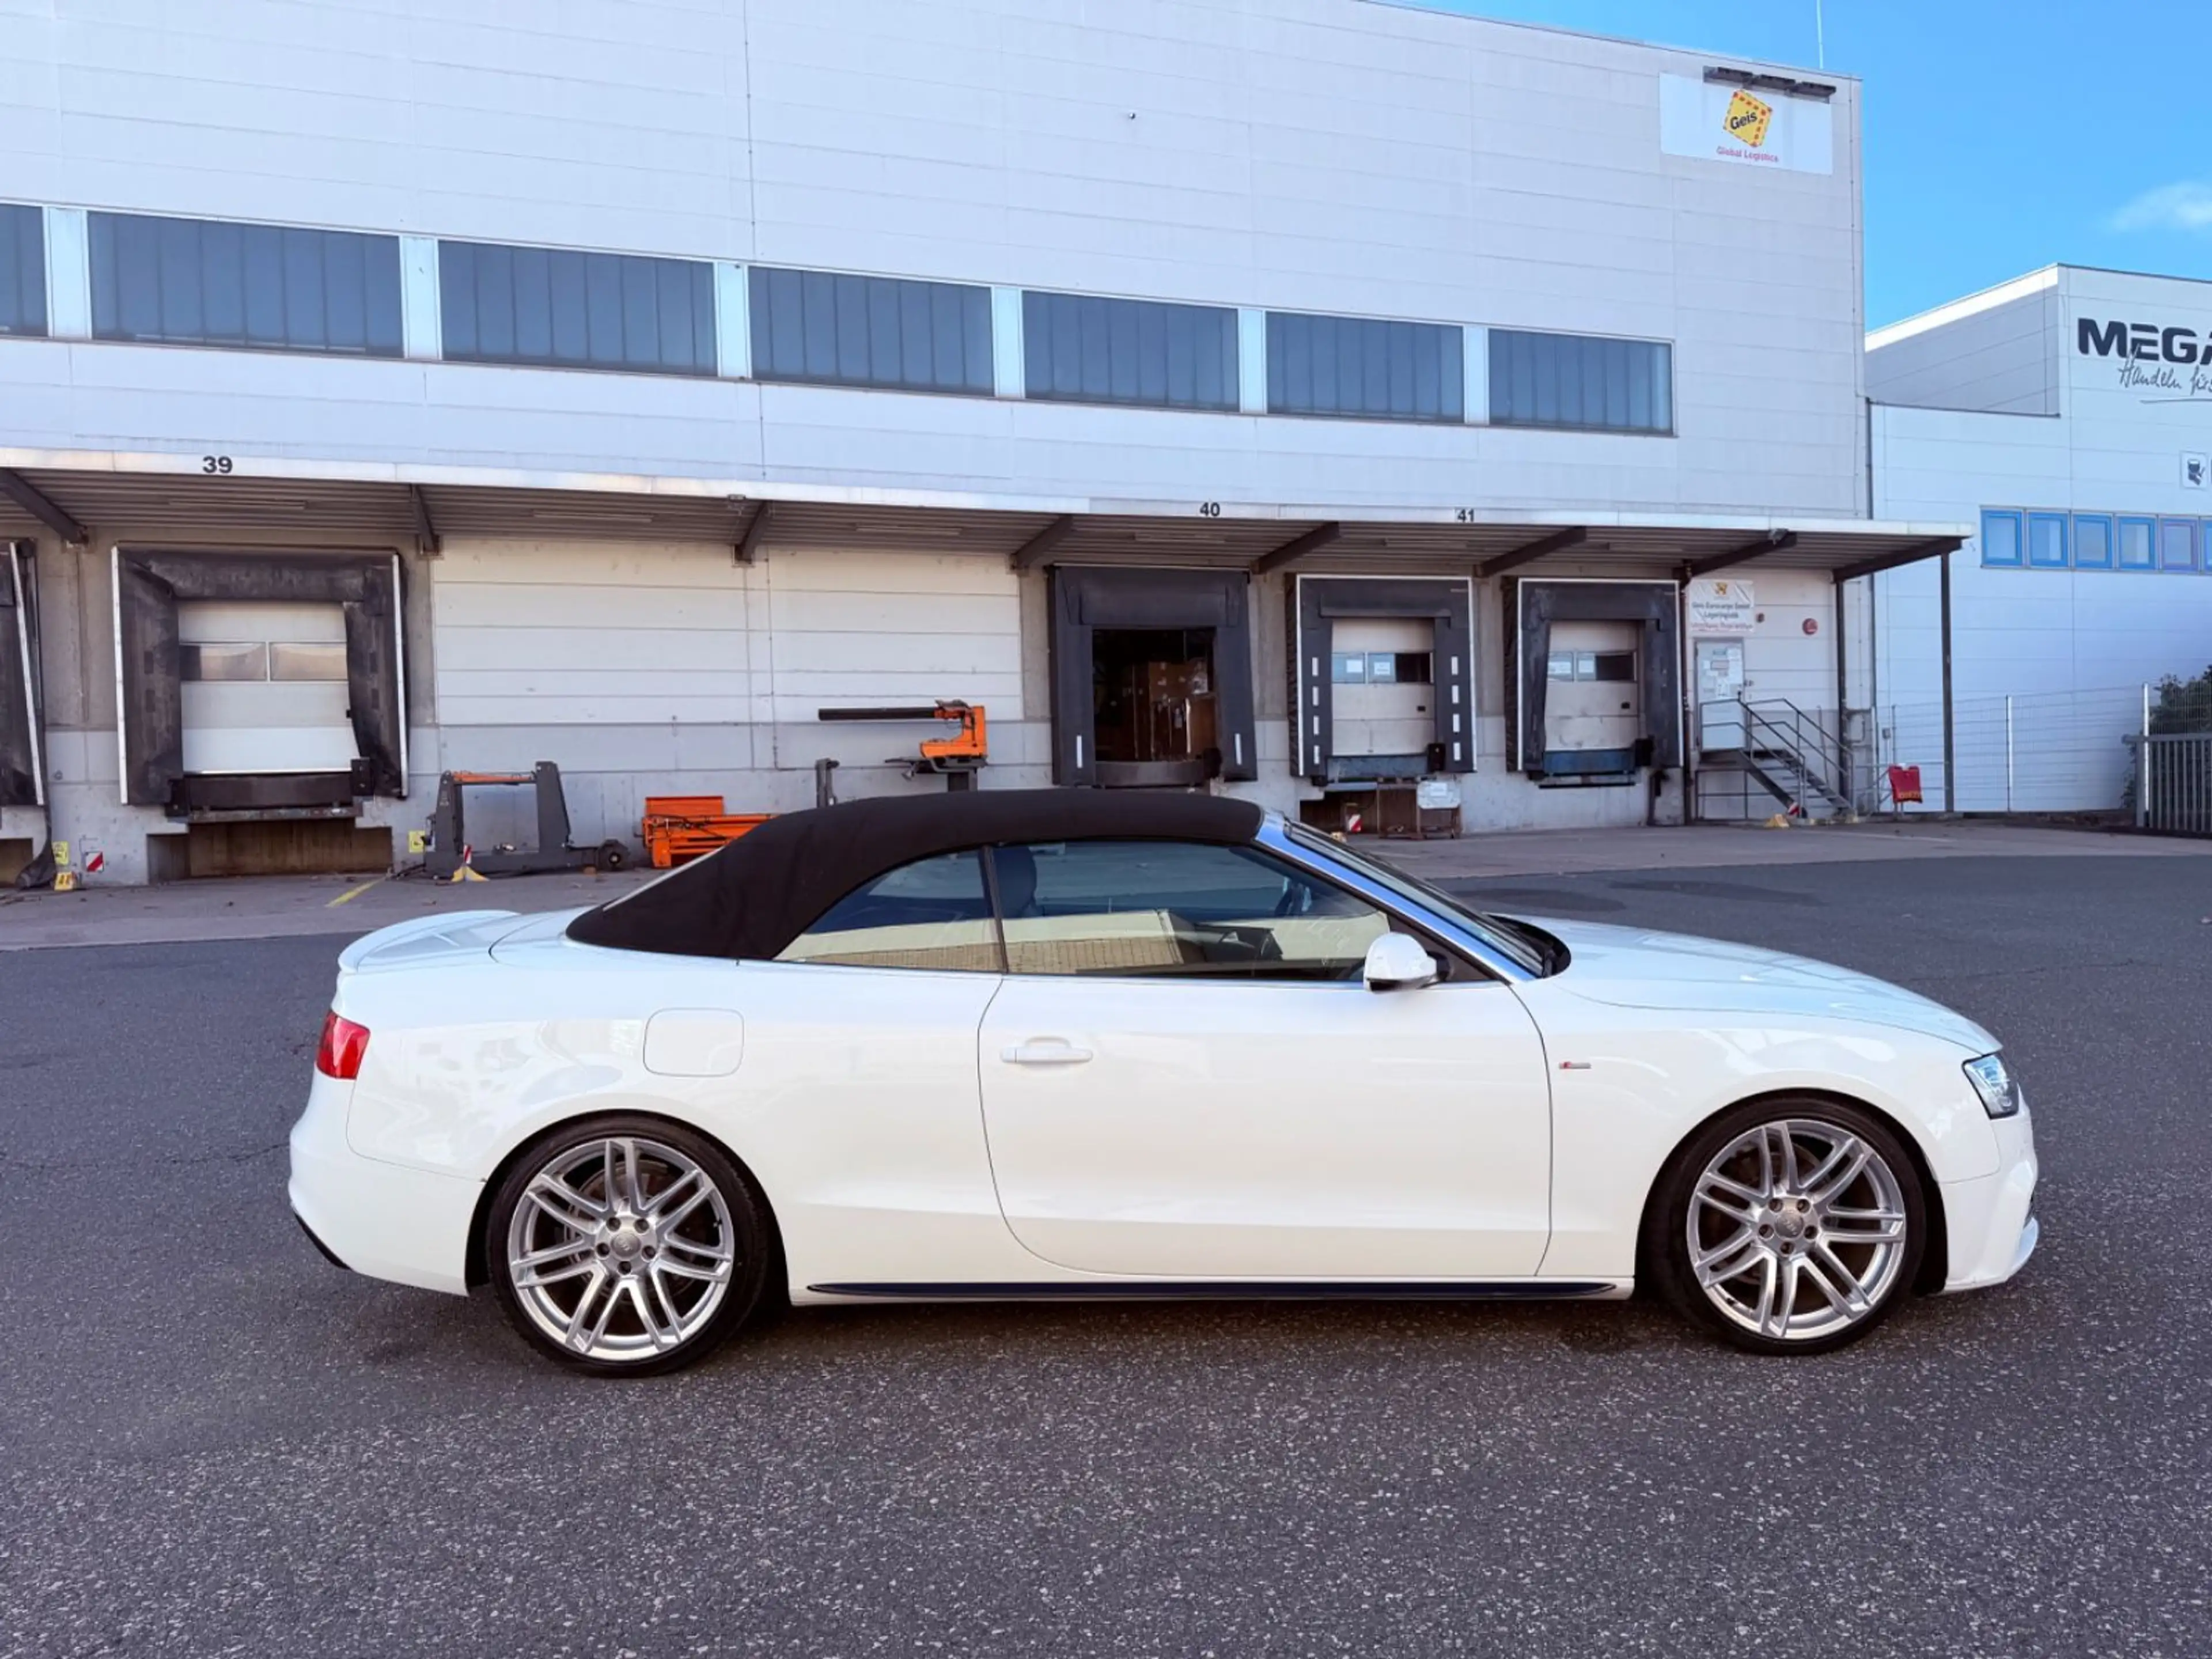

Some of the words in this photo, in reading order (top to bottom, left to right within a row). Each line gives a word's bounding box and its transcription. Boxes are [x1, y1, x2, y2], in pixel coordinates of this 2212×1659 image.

[1730, 111, 1758, 130] Geis
[2118, 342, 2182, 389] Handeln
[203, 455, 233, 474] 39
[1199, 501, 1220, 517] 40
[1457, 508, 1474, 522] 41
